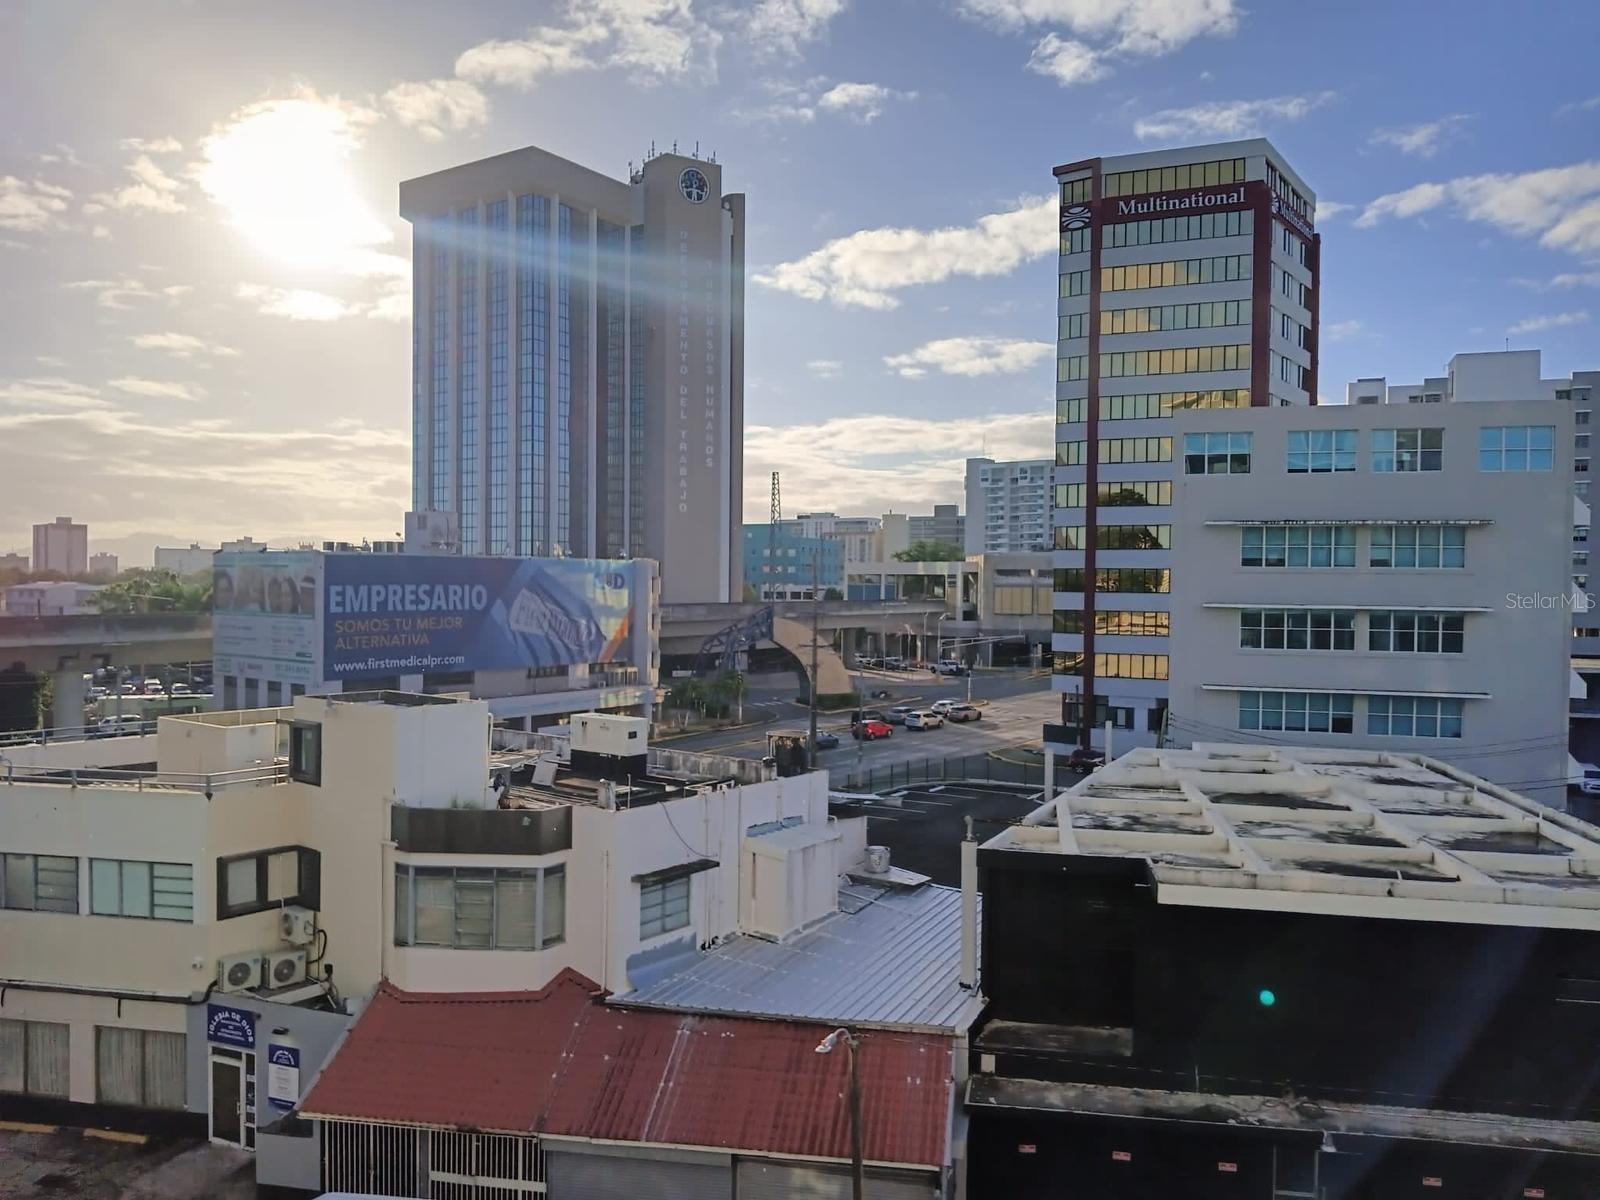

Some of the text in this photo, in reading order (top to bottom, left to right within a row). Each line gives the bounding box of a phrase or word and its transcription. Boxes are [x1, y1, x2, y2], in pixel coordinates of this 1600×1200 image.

[1118, 187, 1245, 215] Multinational
[679, 385, 688, 419] DEL
[705, 385, 715, 468] HUMANOS
[679, 430, 688, 513] TRABAJO
[329, 583, 489, 613] EMPRESARIO
[335, 616, 463, 633] SOMOS TU MEJOR
[335, 633, 430, 650] ALTERNATIVA
[333, 653, 465, 673] www.firstmedicalpr.com
[208, 1011, 254, 1043] IGLESIA DE DIOS
